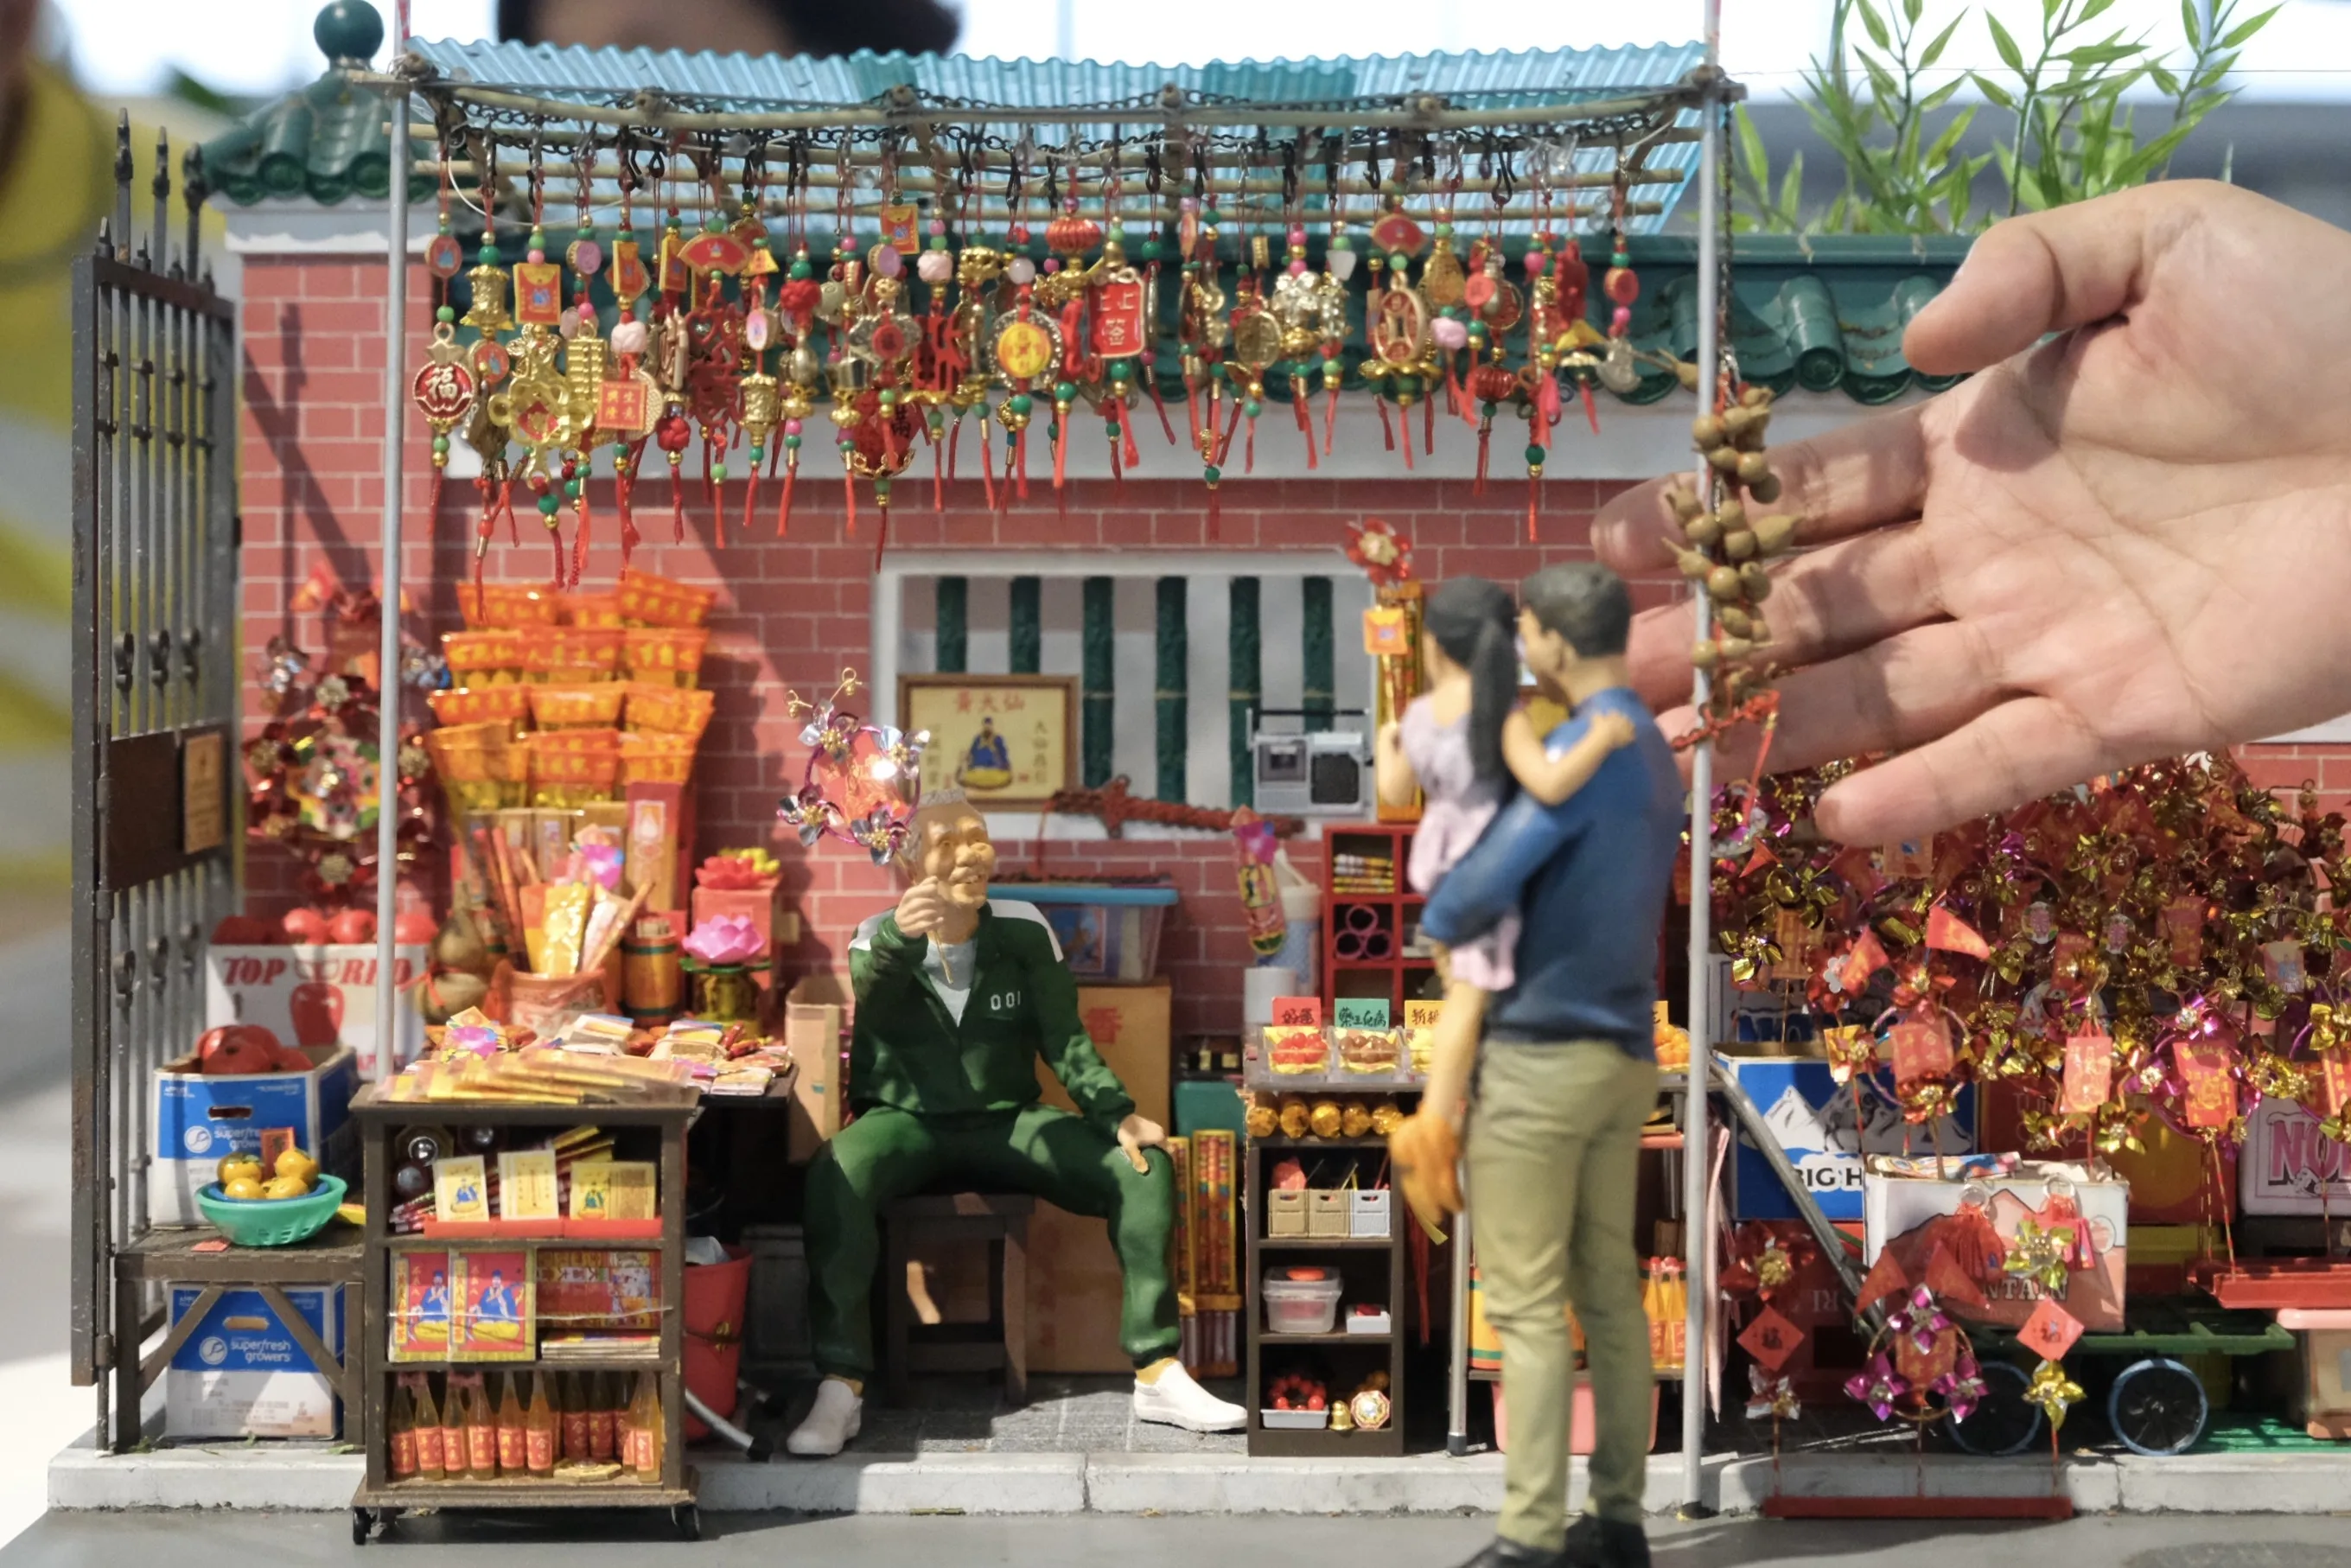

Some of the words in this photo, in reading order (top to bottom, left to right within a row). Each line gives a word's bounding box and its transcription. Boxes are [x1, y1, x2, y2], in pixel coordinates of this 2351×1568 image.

[424, 365, 459, 402] 福
[223, 958, 286, 985] TOP
[990, 990, 1021, 1011] 001
[1084, 1006, 1123, 1044] 香
[230, 1336, 292, 1353] superfresh
[245, 1352, 291, 1364] growers
